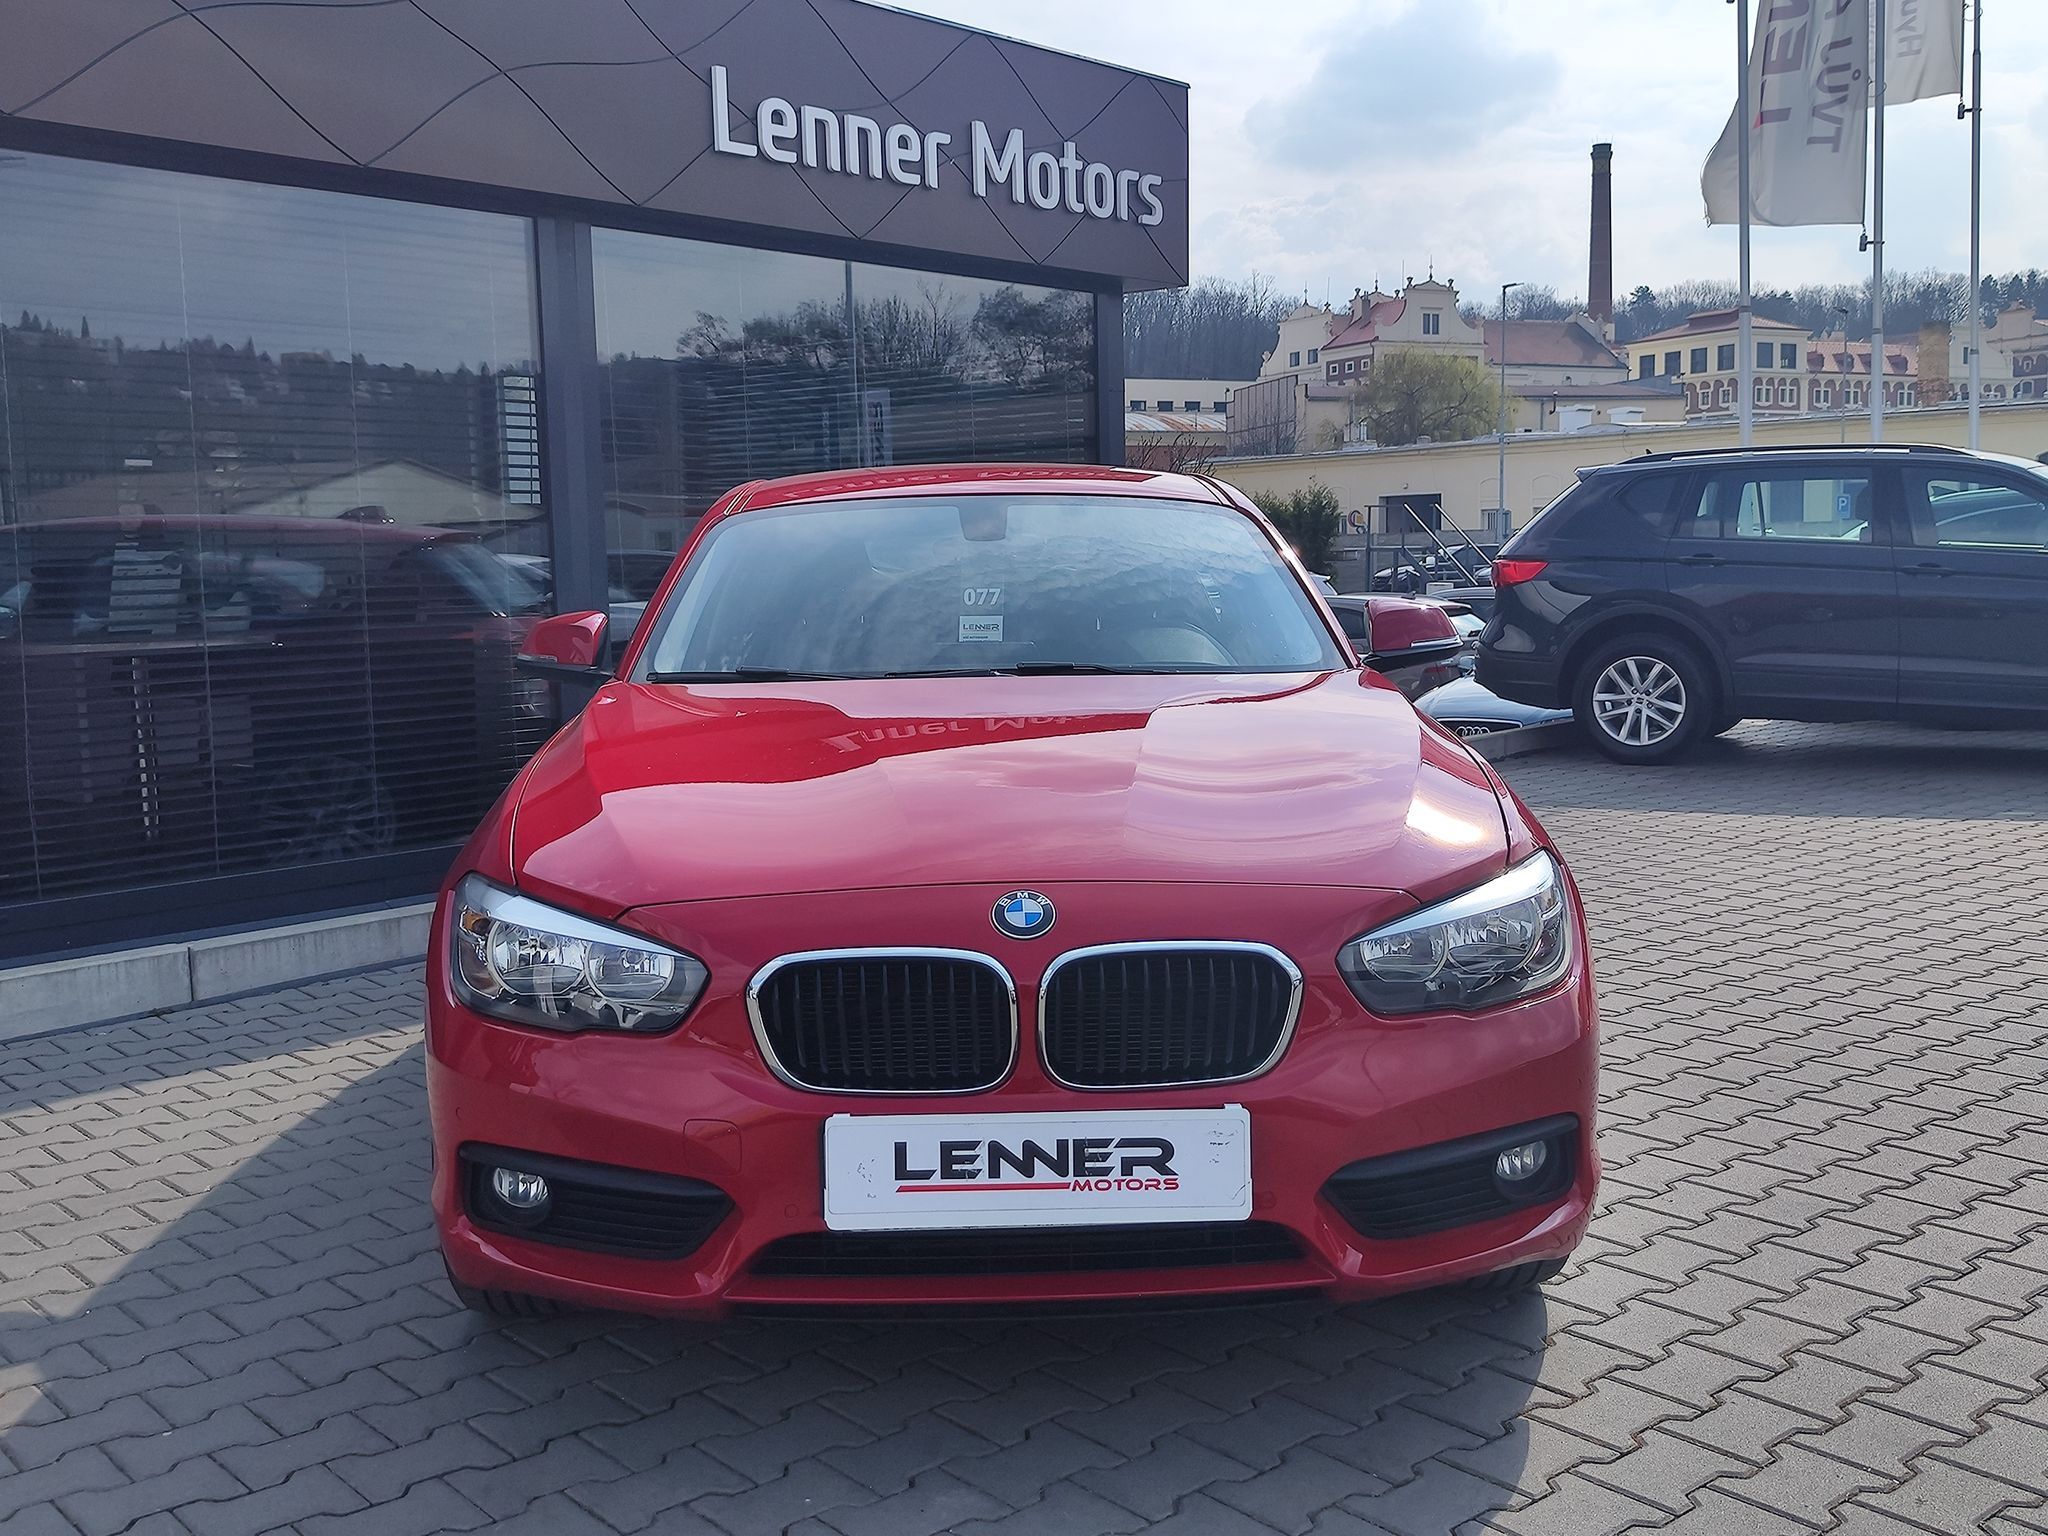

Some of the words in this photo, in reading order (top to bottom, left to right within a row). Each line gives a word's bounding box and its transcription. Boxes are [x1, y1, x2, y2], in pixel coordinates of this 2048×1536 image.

[710, 63, 952, 190] Lenner
[970, 119, 1164, 227] Motors
[1838, 497, 1848, 512] P
[963, 588, 1001, 606] 077
[998, 891, 1050, 907] BMW
[894, 1137, 1179, 1182] LENNER
[1071, 1177, 1180, 1193] MOTORS
